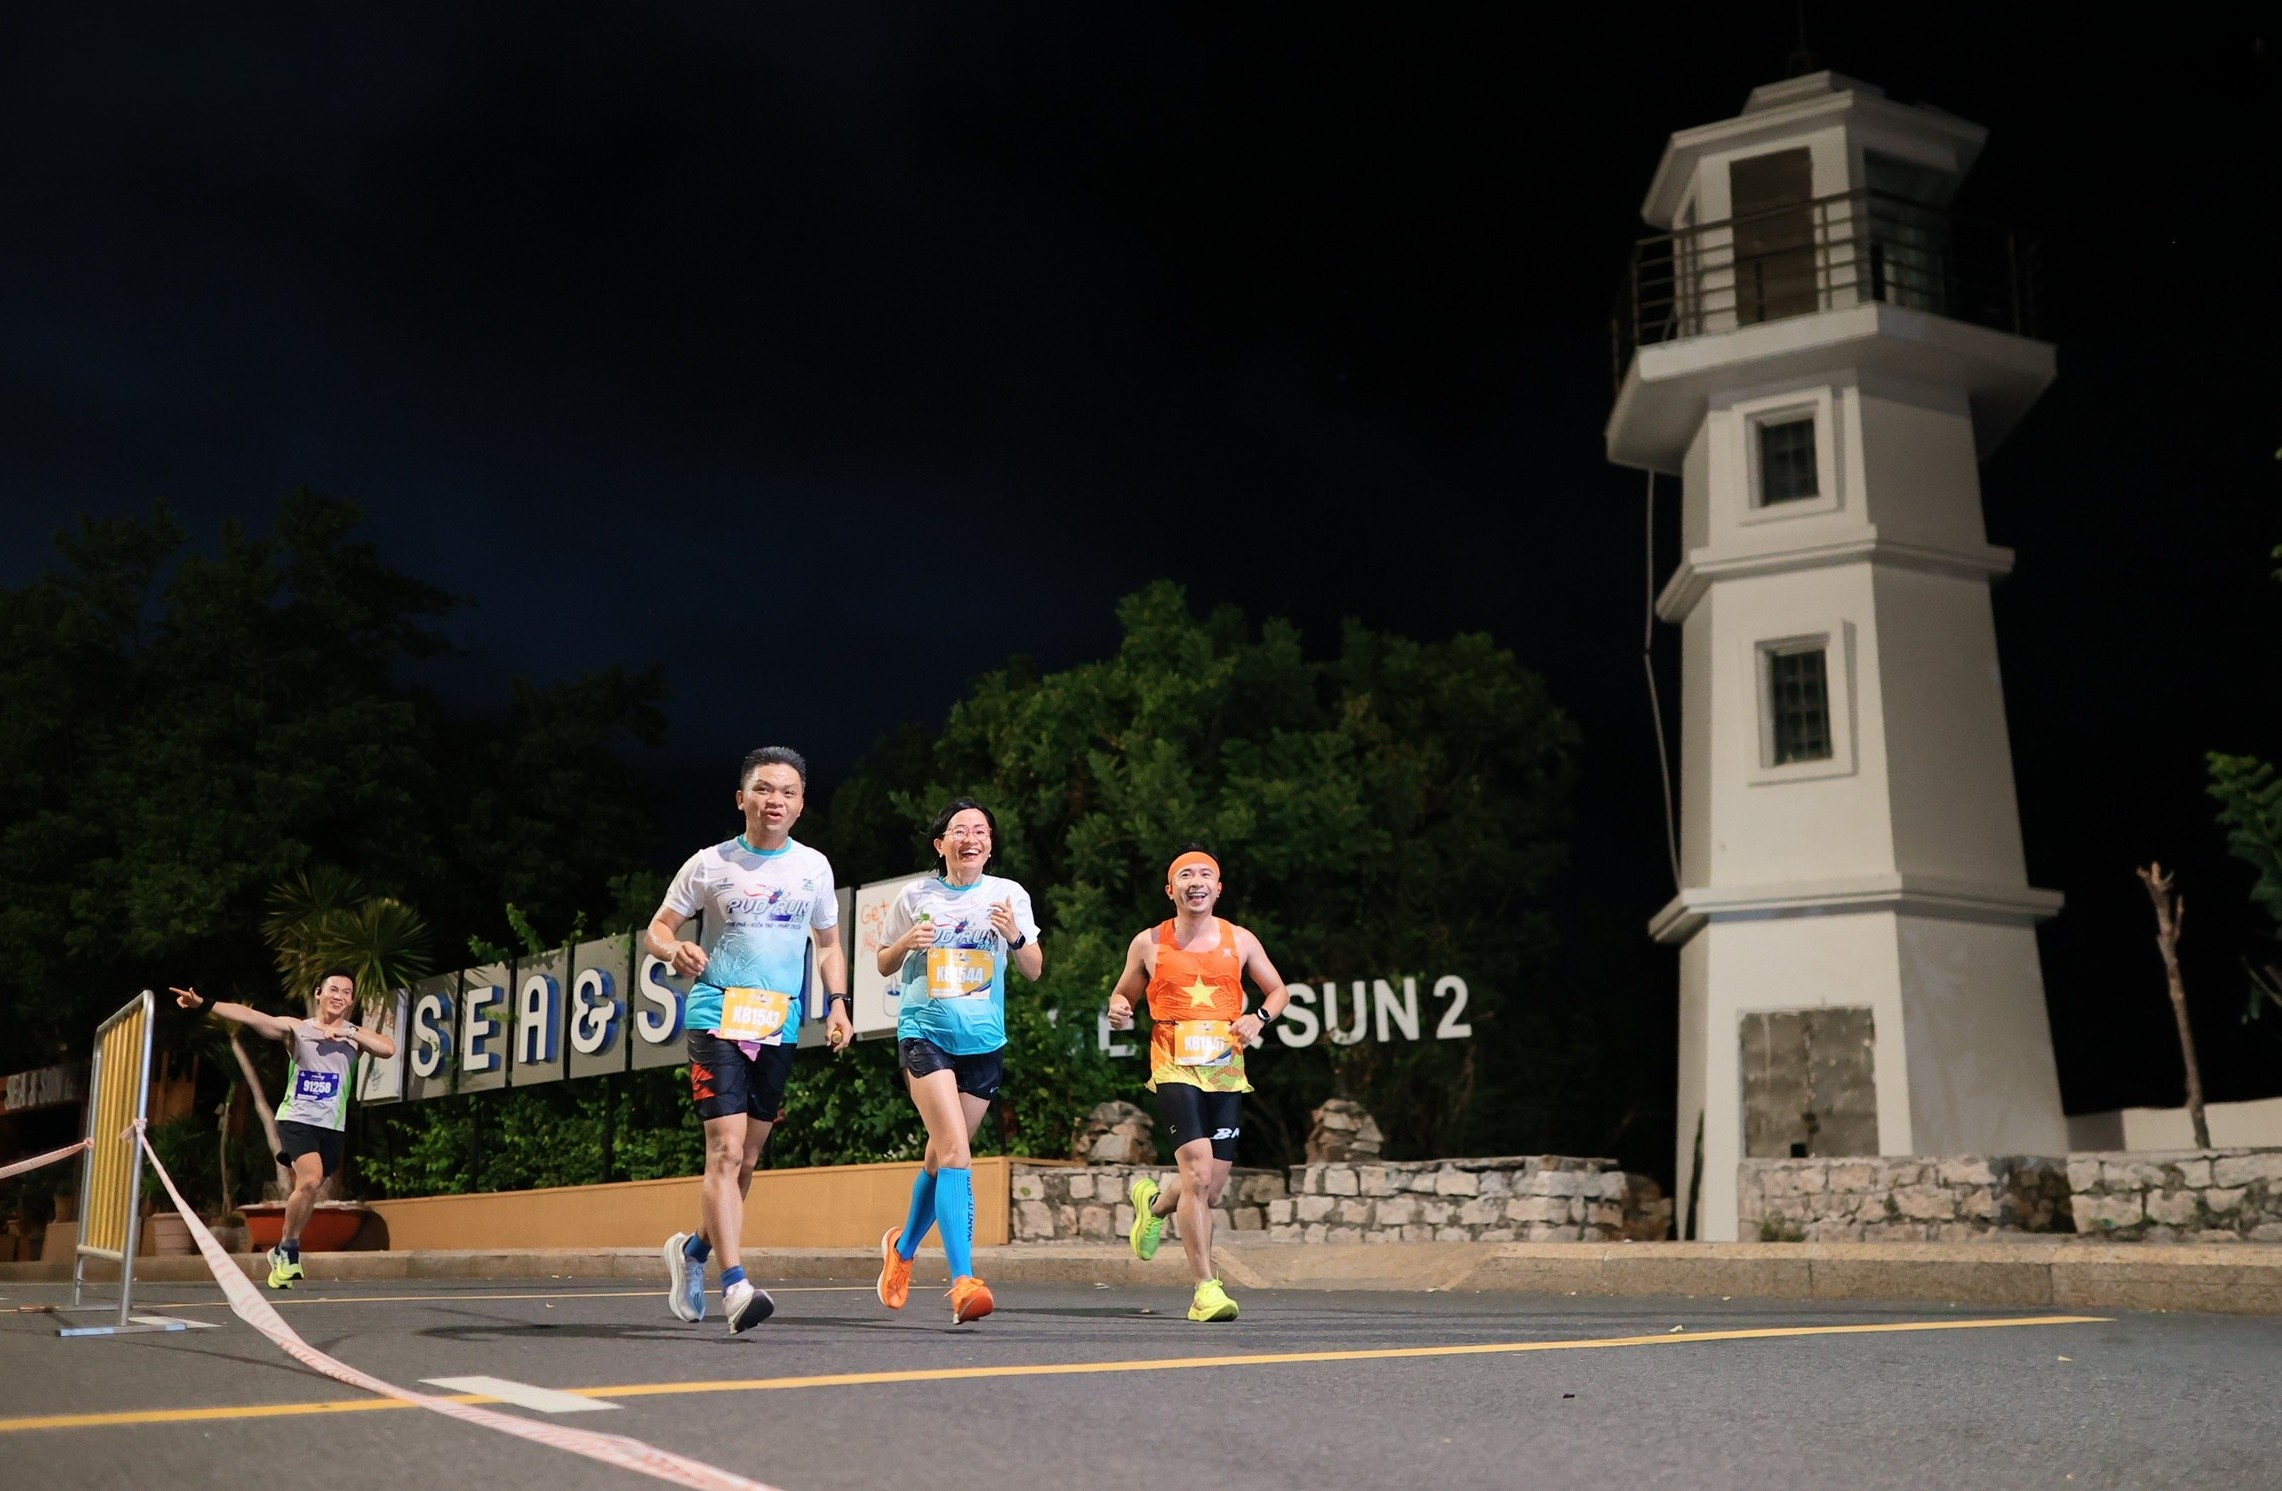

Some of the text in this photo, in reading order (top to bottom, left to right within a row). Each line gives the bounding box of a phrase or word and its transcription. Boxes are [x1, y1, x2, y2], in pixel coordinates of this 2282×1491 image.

[771, 900, 809, 916] RUN
[1433, 975, 1472, 1039] 2
[302, 1079, 332, 1094] 91258
